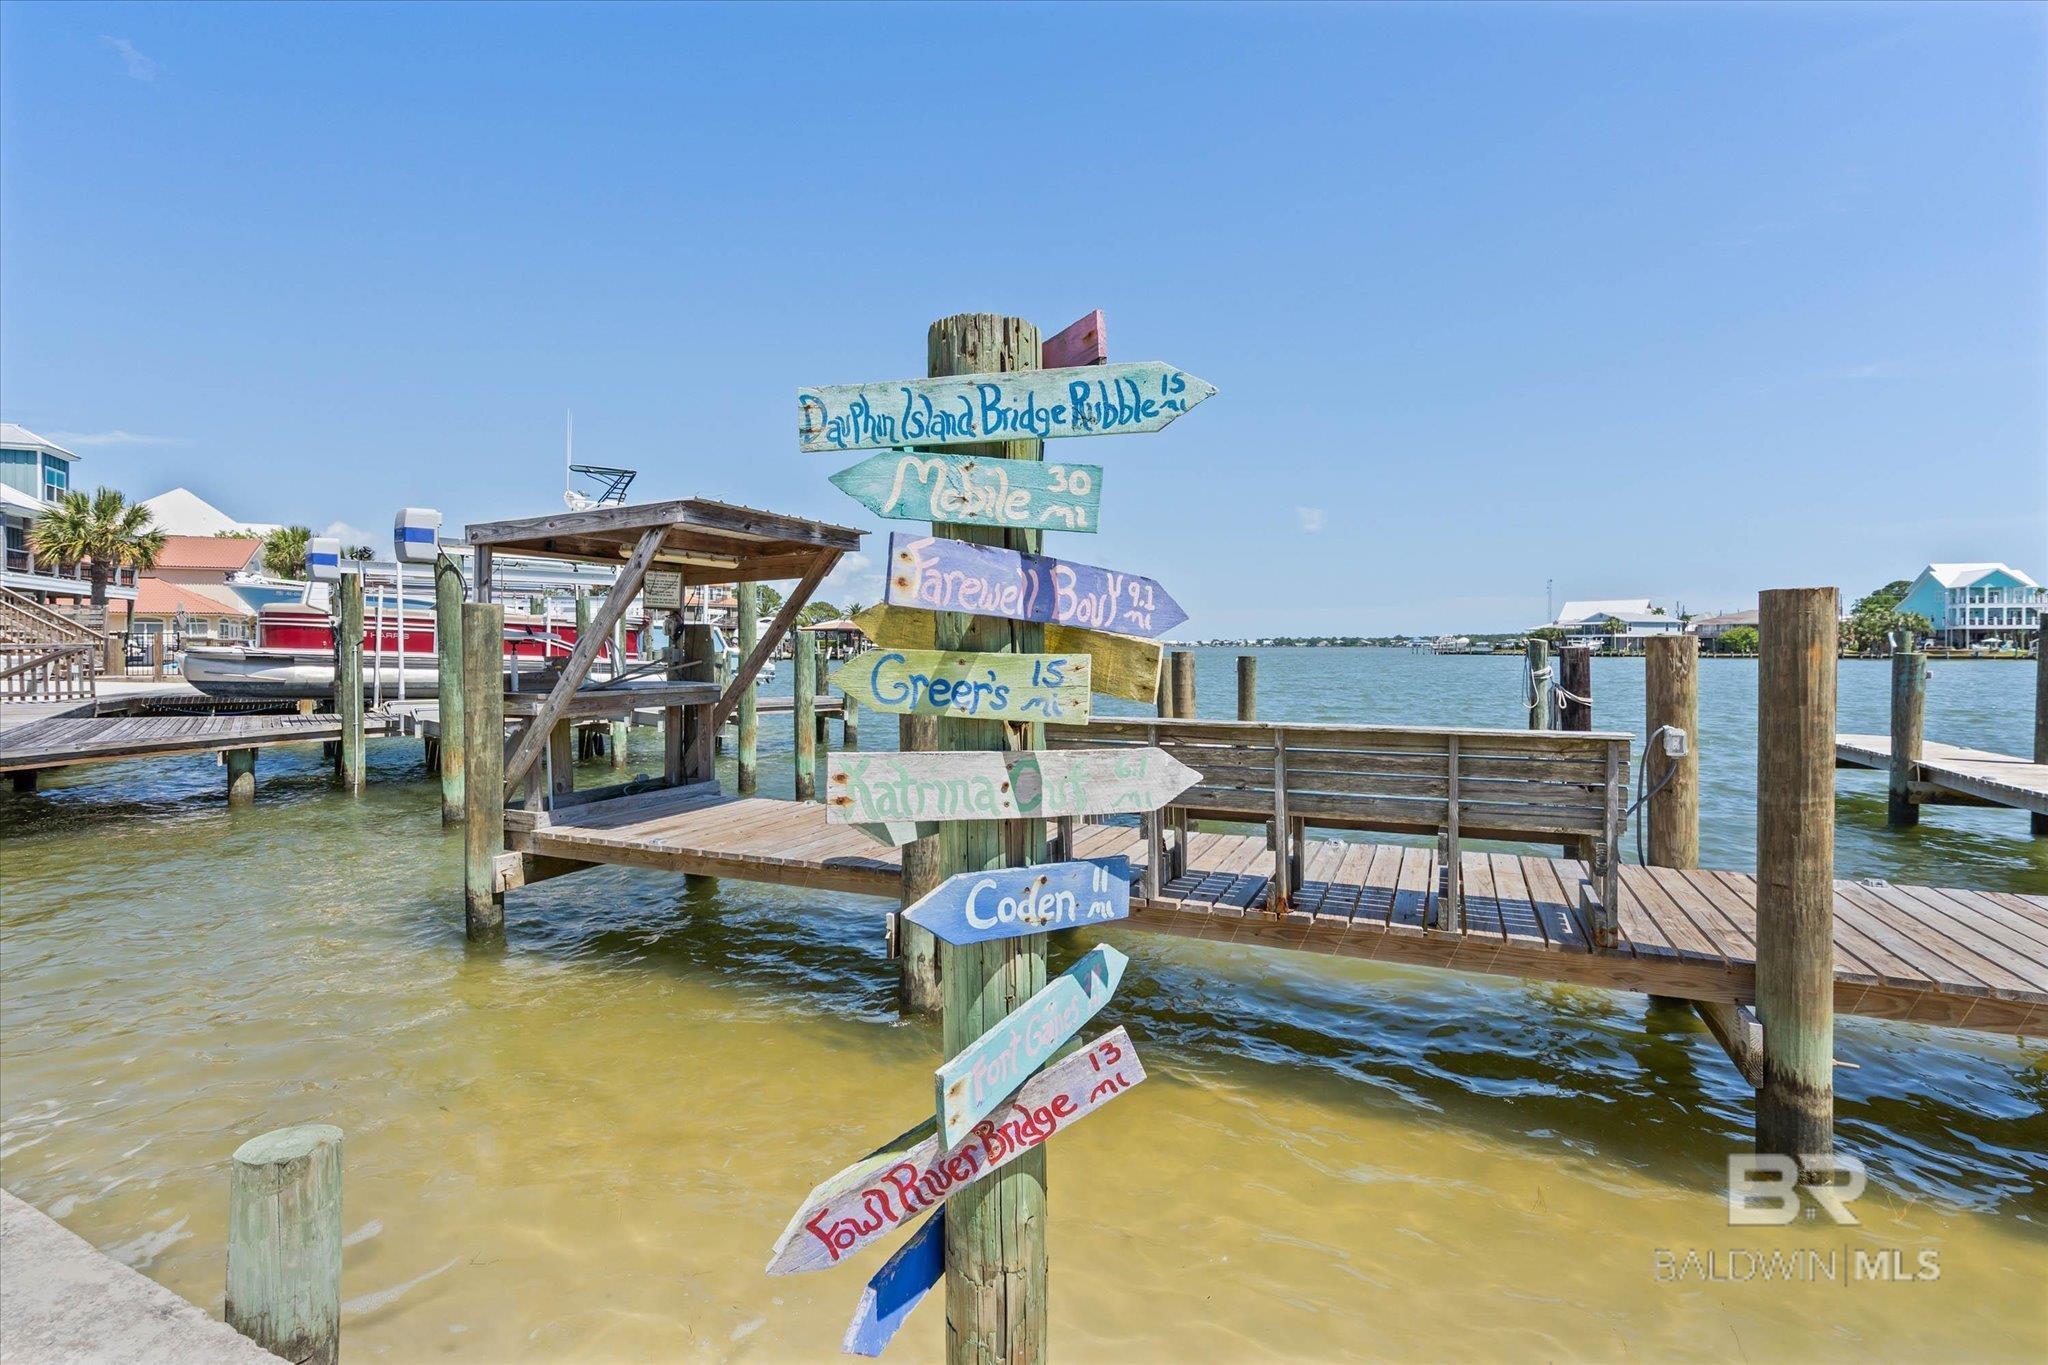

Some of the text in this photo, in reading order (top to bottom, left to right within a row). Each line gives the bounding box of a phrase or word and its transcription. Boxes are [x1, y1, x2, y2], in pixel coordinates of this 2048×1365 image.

[900, 387, 976, 441] Island
[977, 383, 1067, 440] Bridge
[1068, 377, 1159, 431] Rubble
[883, 455, 1031, 522] Mobile
[1047, 465, 1092, 495] 30
[1039, 504, 1088, 528] mi
[906, 537, 1040, 618] Farewell
[1128, 580, 1156, 611] 9.1
[1124, 609, 1153, 631] mi
[870, 653, 1010, 715] Greer's
[1032, 659, 1067, 689] 15
[1020, 692, 1064, 718] mi
[839, 755, 1090, 820] Katrina Cut
[1092, 865, 1109, 893] 11
[965, 875, 1076, 930] Coden
[1087, 900, 1115, 919] mi
[971, 995, 1081, 1104] Fort Gaines
[1089, 1041, 1122, 1072] 13
[1090, 1072, 1131, 1104] mi
[805, 1094, 1078, 1261] Fowl River Bridge
